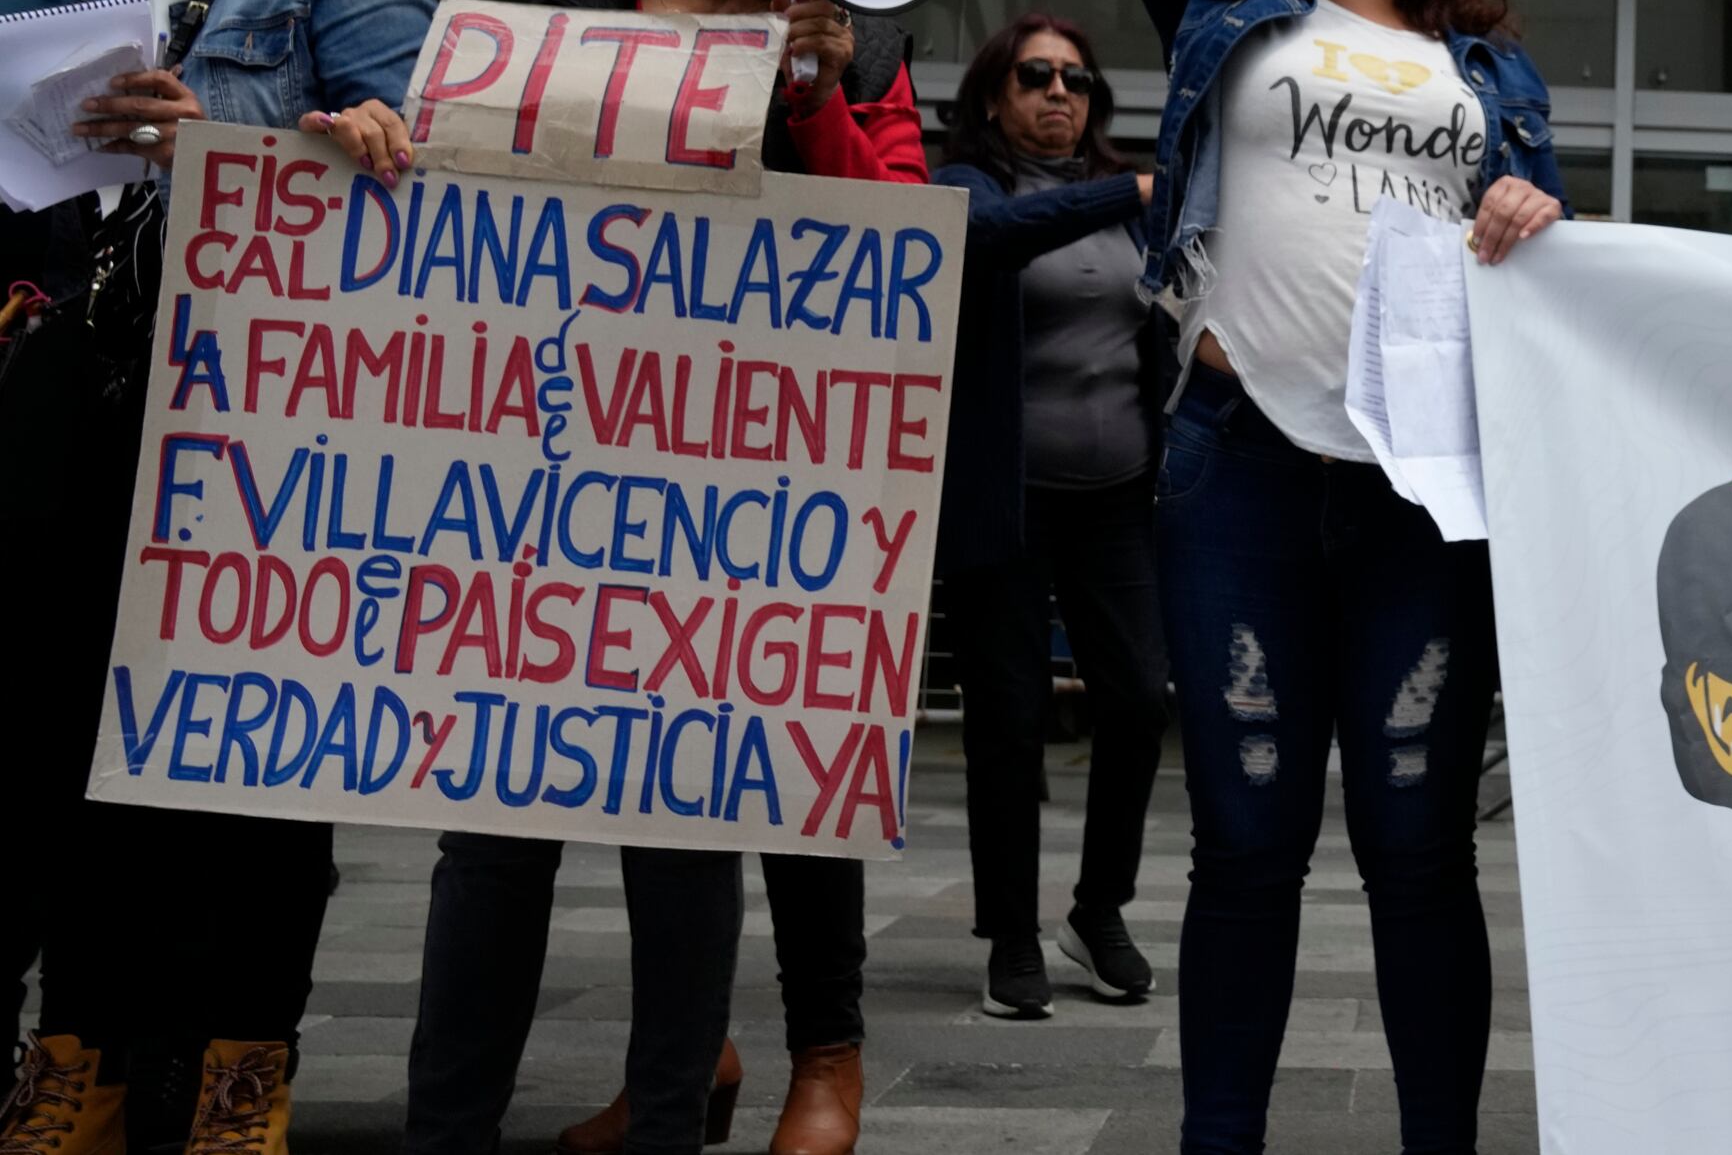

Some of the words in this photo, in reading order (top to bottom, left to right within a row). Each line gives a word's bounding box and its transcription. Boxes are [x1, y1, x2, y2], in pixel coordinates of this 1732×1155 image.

[411, 10, 770, 170] PITE
[1268, 75, 1485, 169] Wonde
[184, 230, 331, 302] CAL
[340, 167, 573, 311] DIANA
[579, 202, 943, 343] SALAZAR
[243, 313, 541, 437] FAMILIA
[574, 341, 943, 474] VALIENTE
[226, 433, 850, 593] VILLAVICENCIO
[140, 545, 351, 658] TODO
[586, 577, 920, 718] EXIGEN
[113, 665, 412, 795] VERDAD
[432, 691, 784, 827] JUSTICIA
